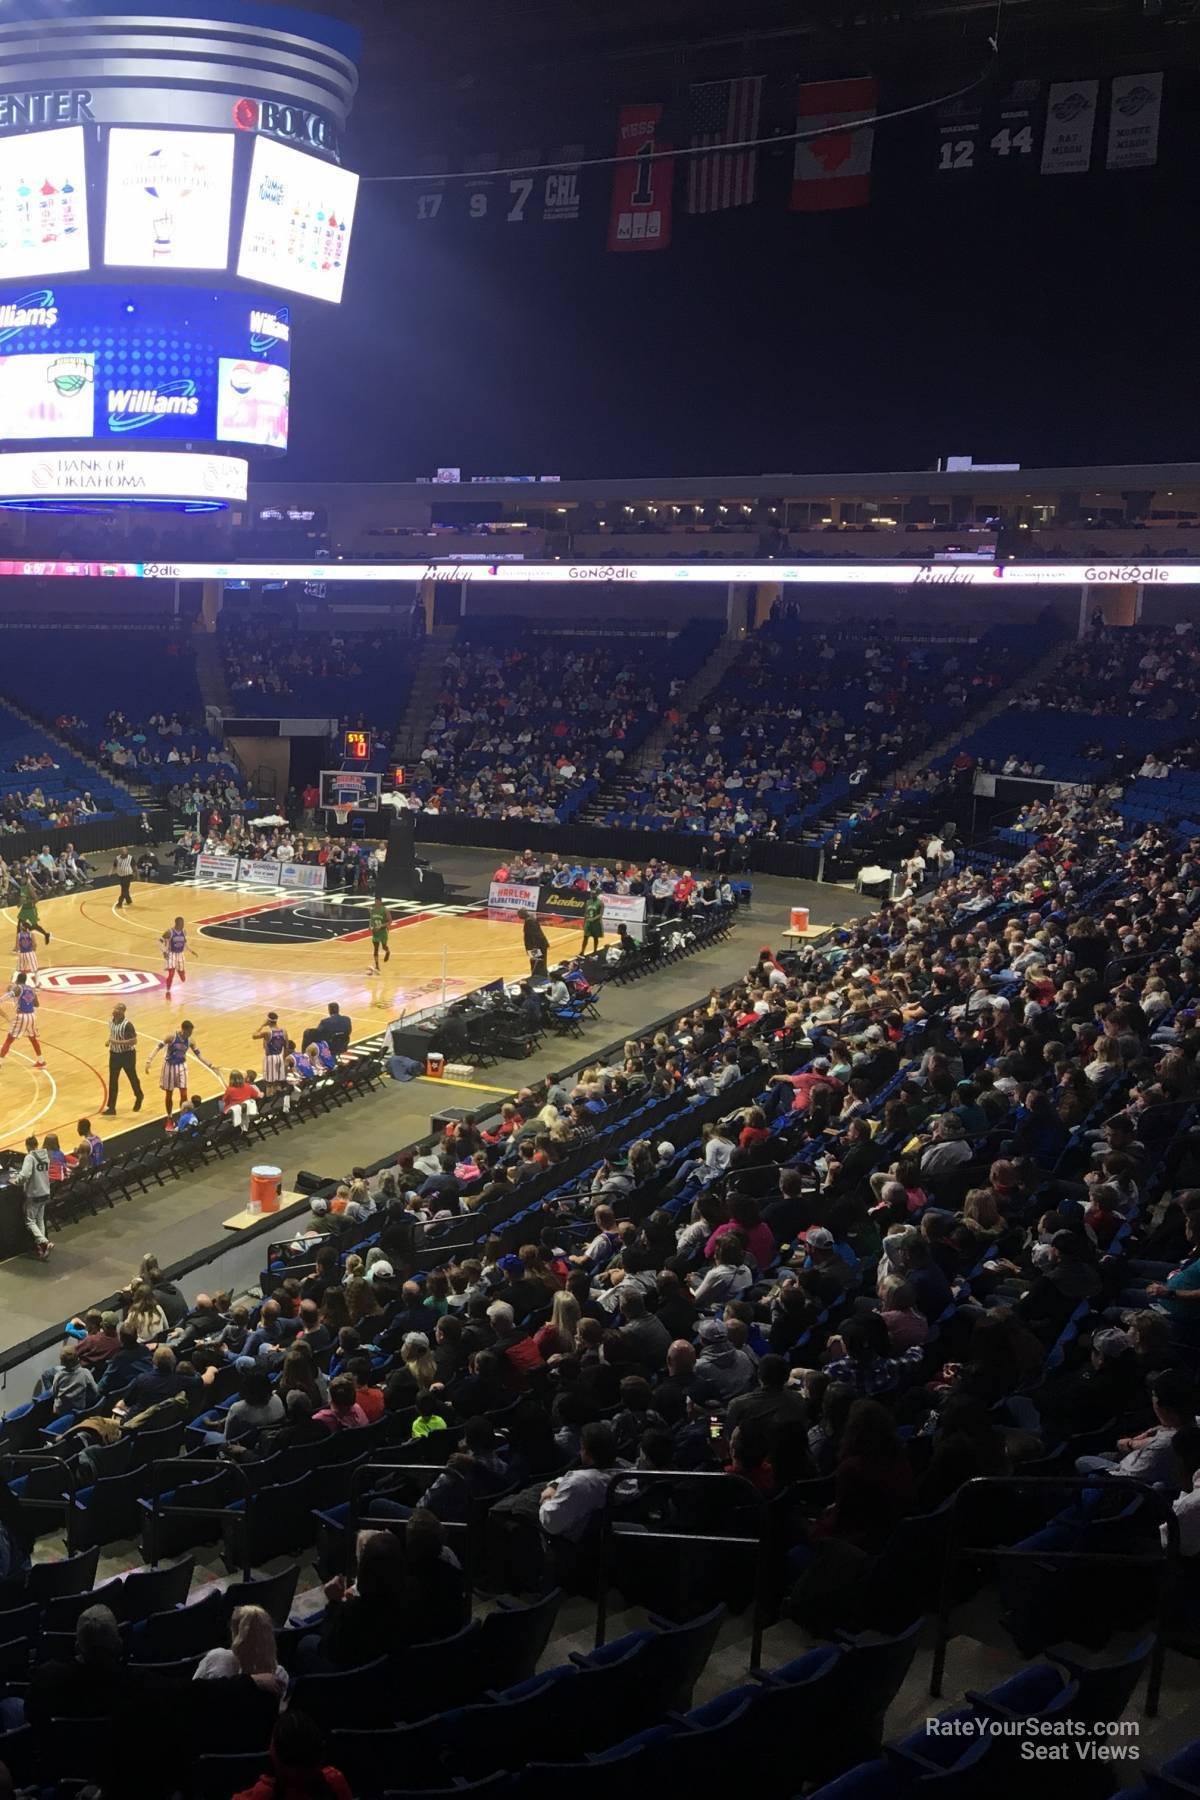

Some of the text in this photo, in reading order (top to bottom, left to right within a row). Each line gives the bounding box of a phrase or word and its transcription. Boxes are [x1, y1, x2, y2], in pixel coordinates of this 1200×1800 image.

[257, 102, 308, 141] BOK
[990, 125, 1035, 156] 44
[938, 140, 975, 170] 12
[630, 138, 656, 207] 1
[506, 177, 534, 222] 7
[543, 175, 580, 206] CHL
[416, 193, 442, 220] 17
[469, 193, 488, 217] 9
[107, 389, 199, 414] Williams
[57, 459, 128, 473] BANK OF
[56, 475, 147, 488] OKLAHOMA
[568, 565, 638, 582] GoNoodle
[1084, 566, 1170, 585] GoNoodle
[496, 887, 532, 900] HARLEM
[545, 893, 585, 909] Baden
